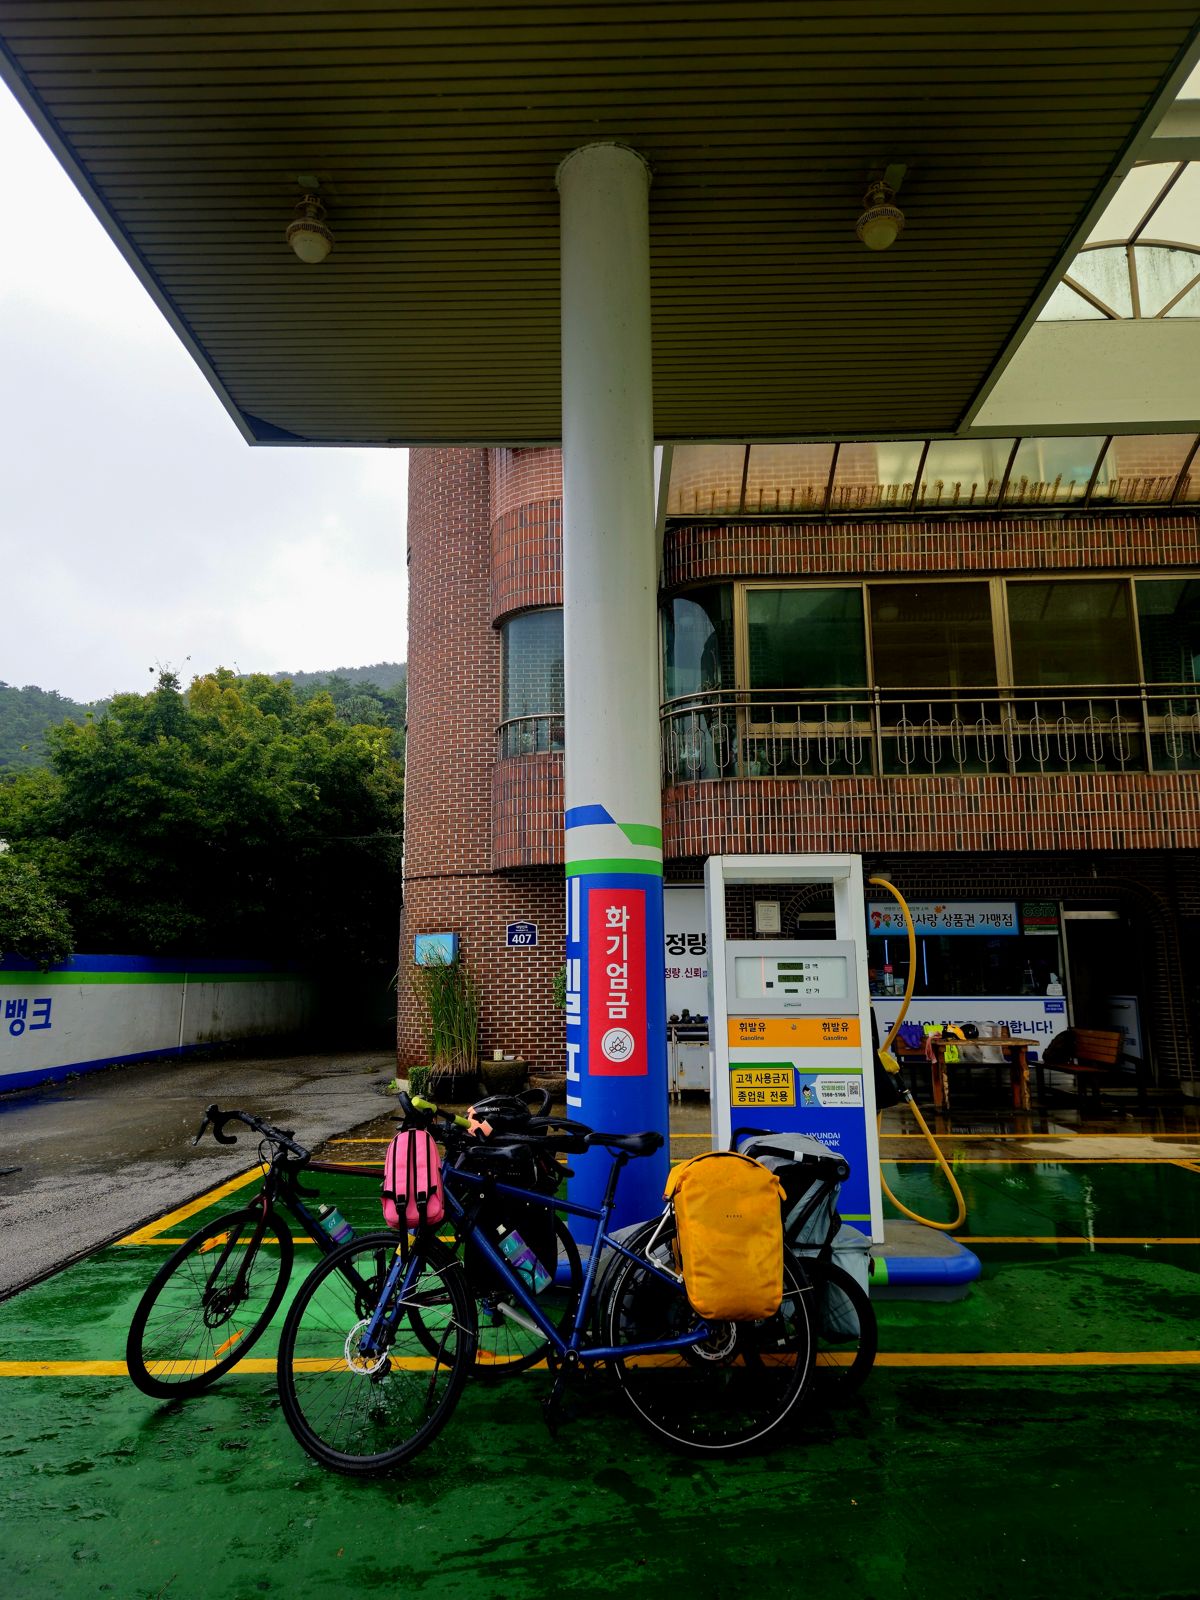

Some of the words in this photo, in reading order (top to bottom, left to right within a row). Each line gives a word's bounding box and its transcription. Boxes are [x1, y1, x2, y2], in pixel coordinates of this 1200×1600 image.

[893, 913, 939, 928] 정사랑
[942, 913, 975, 928] 상품권
[979, 913, 1013, 927] 가맹점
[512, 934, 531, 944] 407
[665, 932, 707, 956] 정량
[605, 905, 630, 1019] 화기엄금
[0, 998, 52, 1036] 뱅크
[739, 1022, 766, 1032] 휘발유
[822, 1022, 849, 1032] 휘발유
[736, 1074, 752, 1084] 고객
[755, 1073, 789, 1084] 사용금지
[738, 1091, 765, 1102] 종업원
[770, 1090, 788, 1102] 전용
